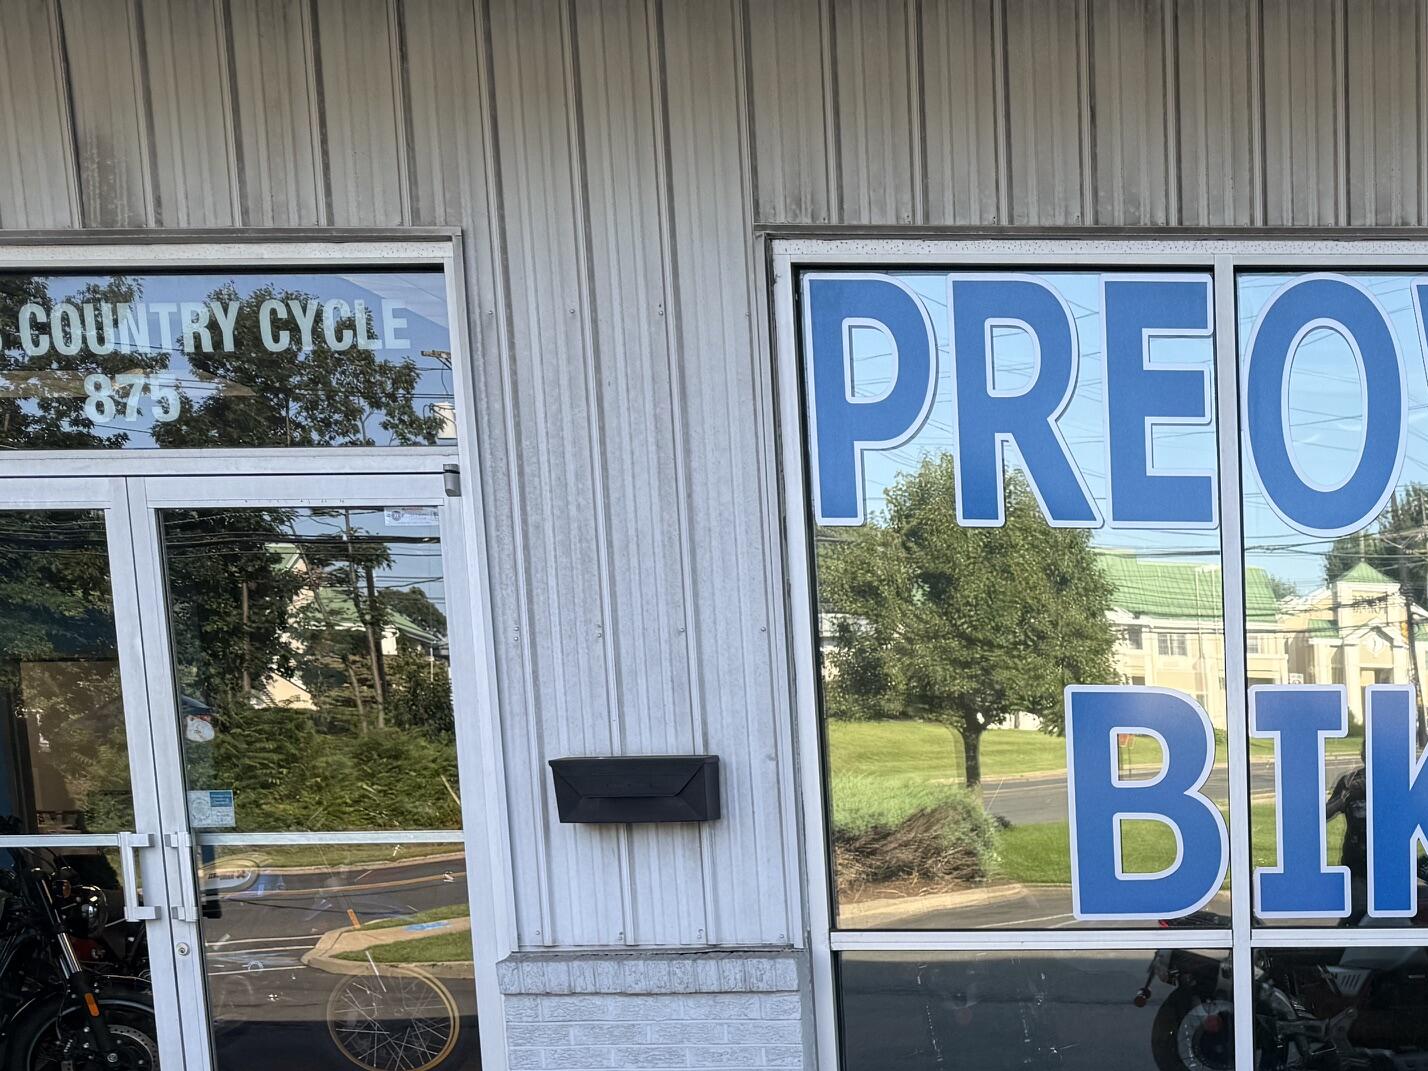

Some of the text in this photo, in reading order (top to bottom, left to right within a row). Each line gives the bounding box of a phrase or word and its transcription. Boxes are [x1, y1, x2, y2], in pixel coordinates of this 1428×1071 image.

[18, 298, 411, 356] COUNTRY CYCLE
[84, 373, 181, 423] 875
